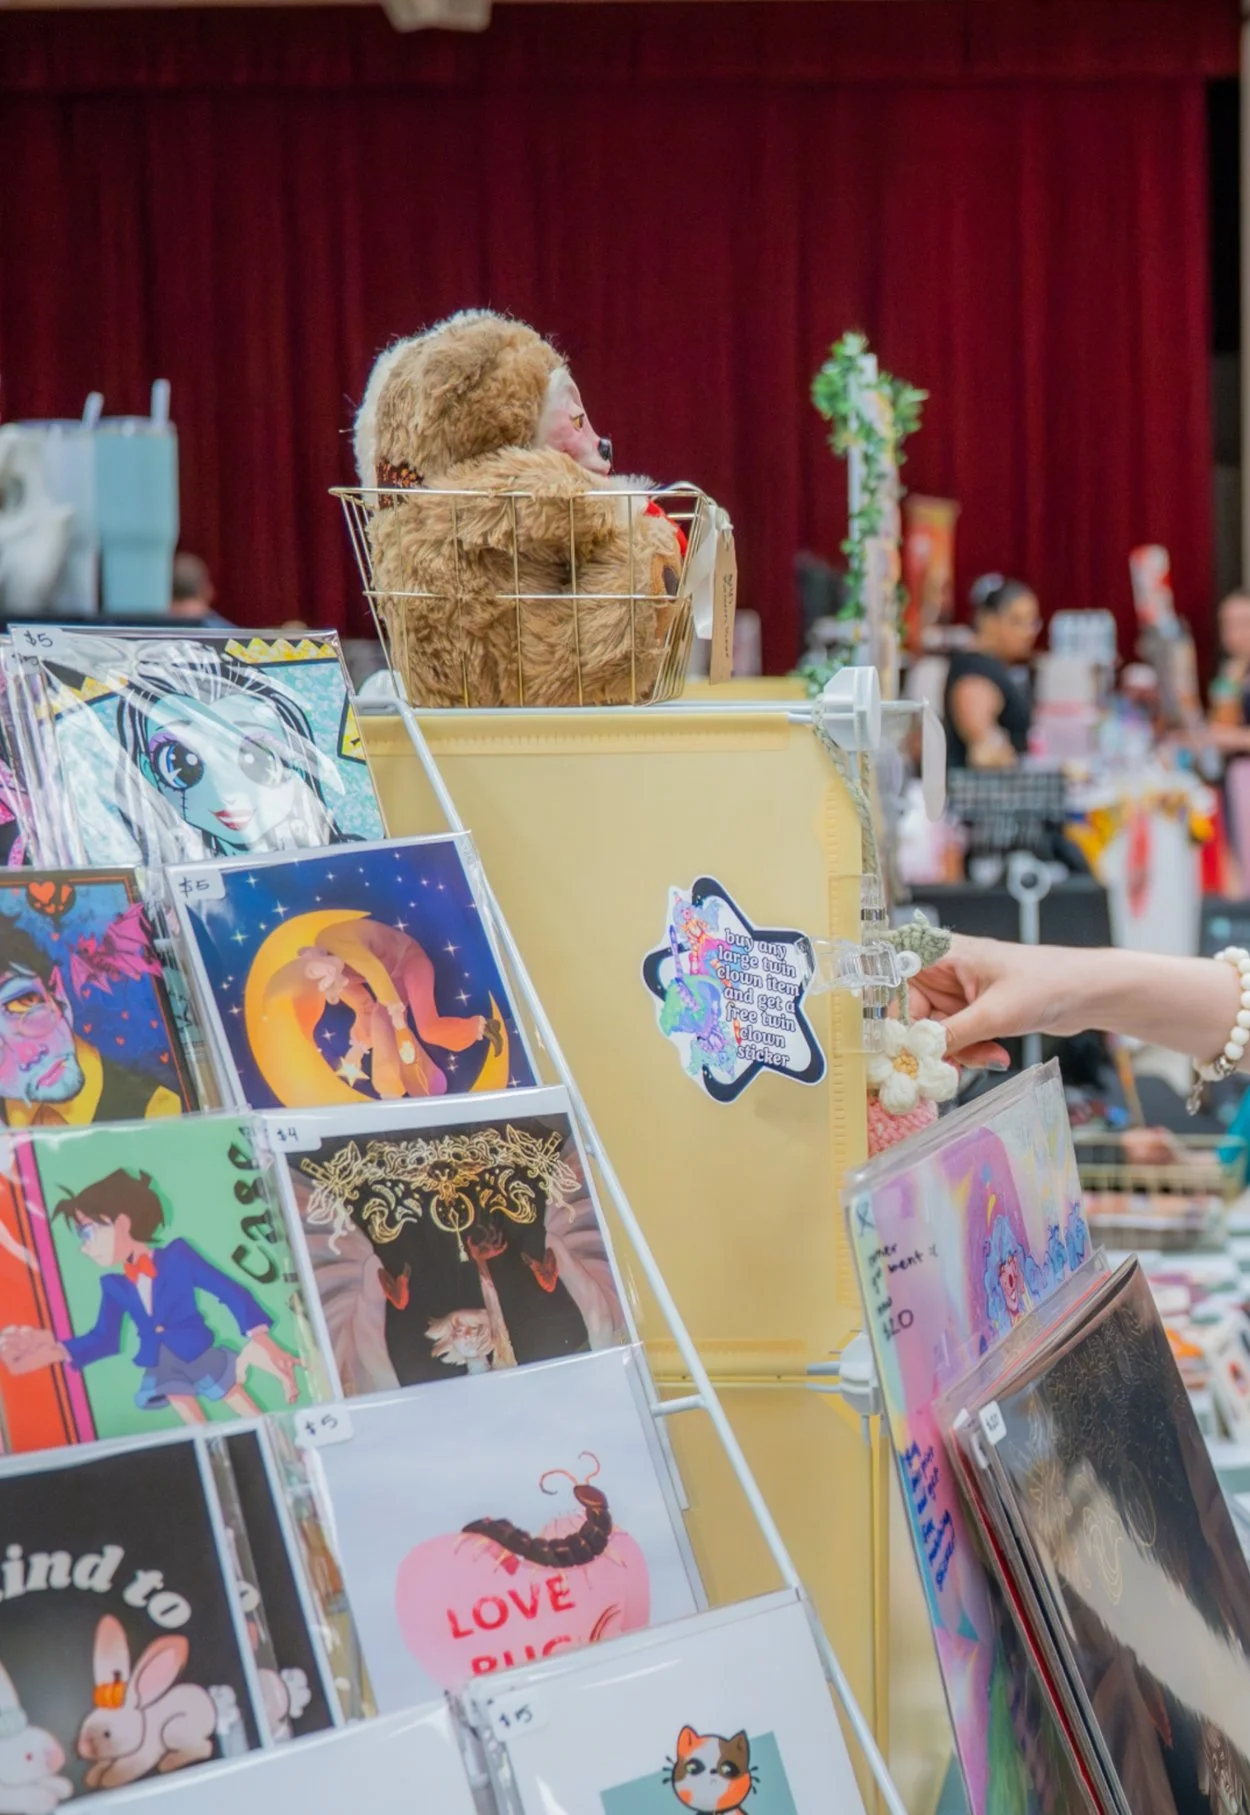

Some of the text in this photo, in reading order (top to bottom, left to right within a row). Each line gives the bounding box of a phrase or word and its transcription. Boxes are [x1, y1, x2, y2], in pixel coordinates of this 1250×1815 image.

[24, 630, 53, 648] $5
[178, 876, 210, 898] $5
[725, 928, 788, 961] buy any
[717, 945, 797, 979] large twin
[716, 967, 800, 997] clown item
[724, 986, 796, 1014] and get a
[725, 1003, 797, 1033] free twin
[740, 1026, 786, 1048] clown
[736, 1043, 790, 1067] sticker
[276, 1127, 299, 1142] $4
[228, 1127, 279, 1285] Case
[305, 1413, 339, 1436] $5
[0, 1543, 125, 1600] ind
[122, 1569, 192, 1629] to
[447, 1574, 576, 1639] LOVE
